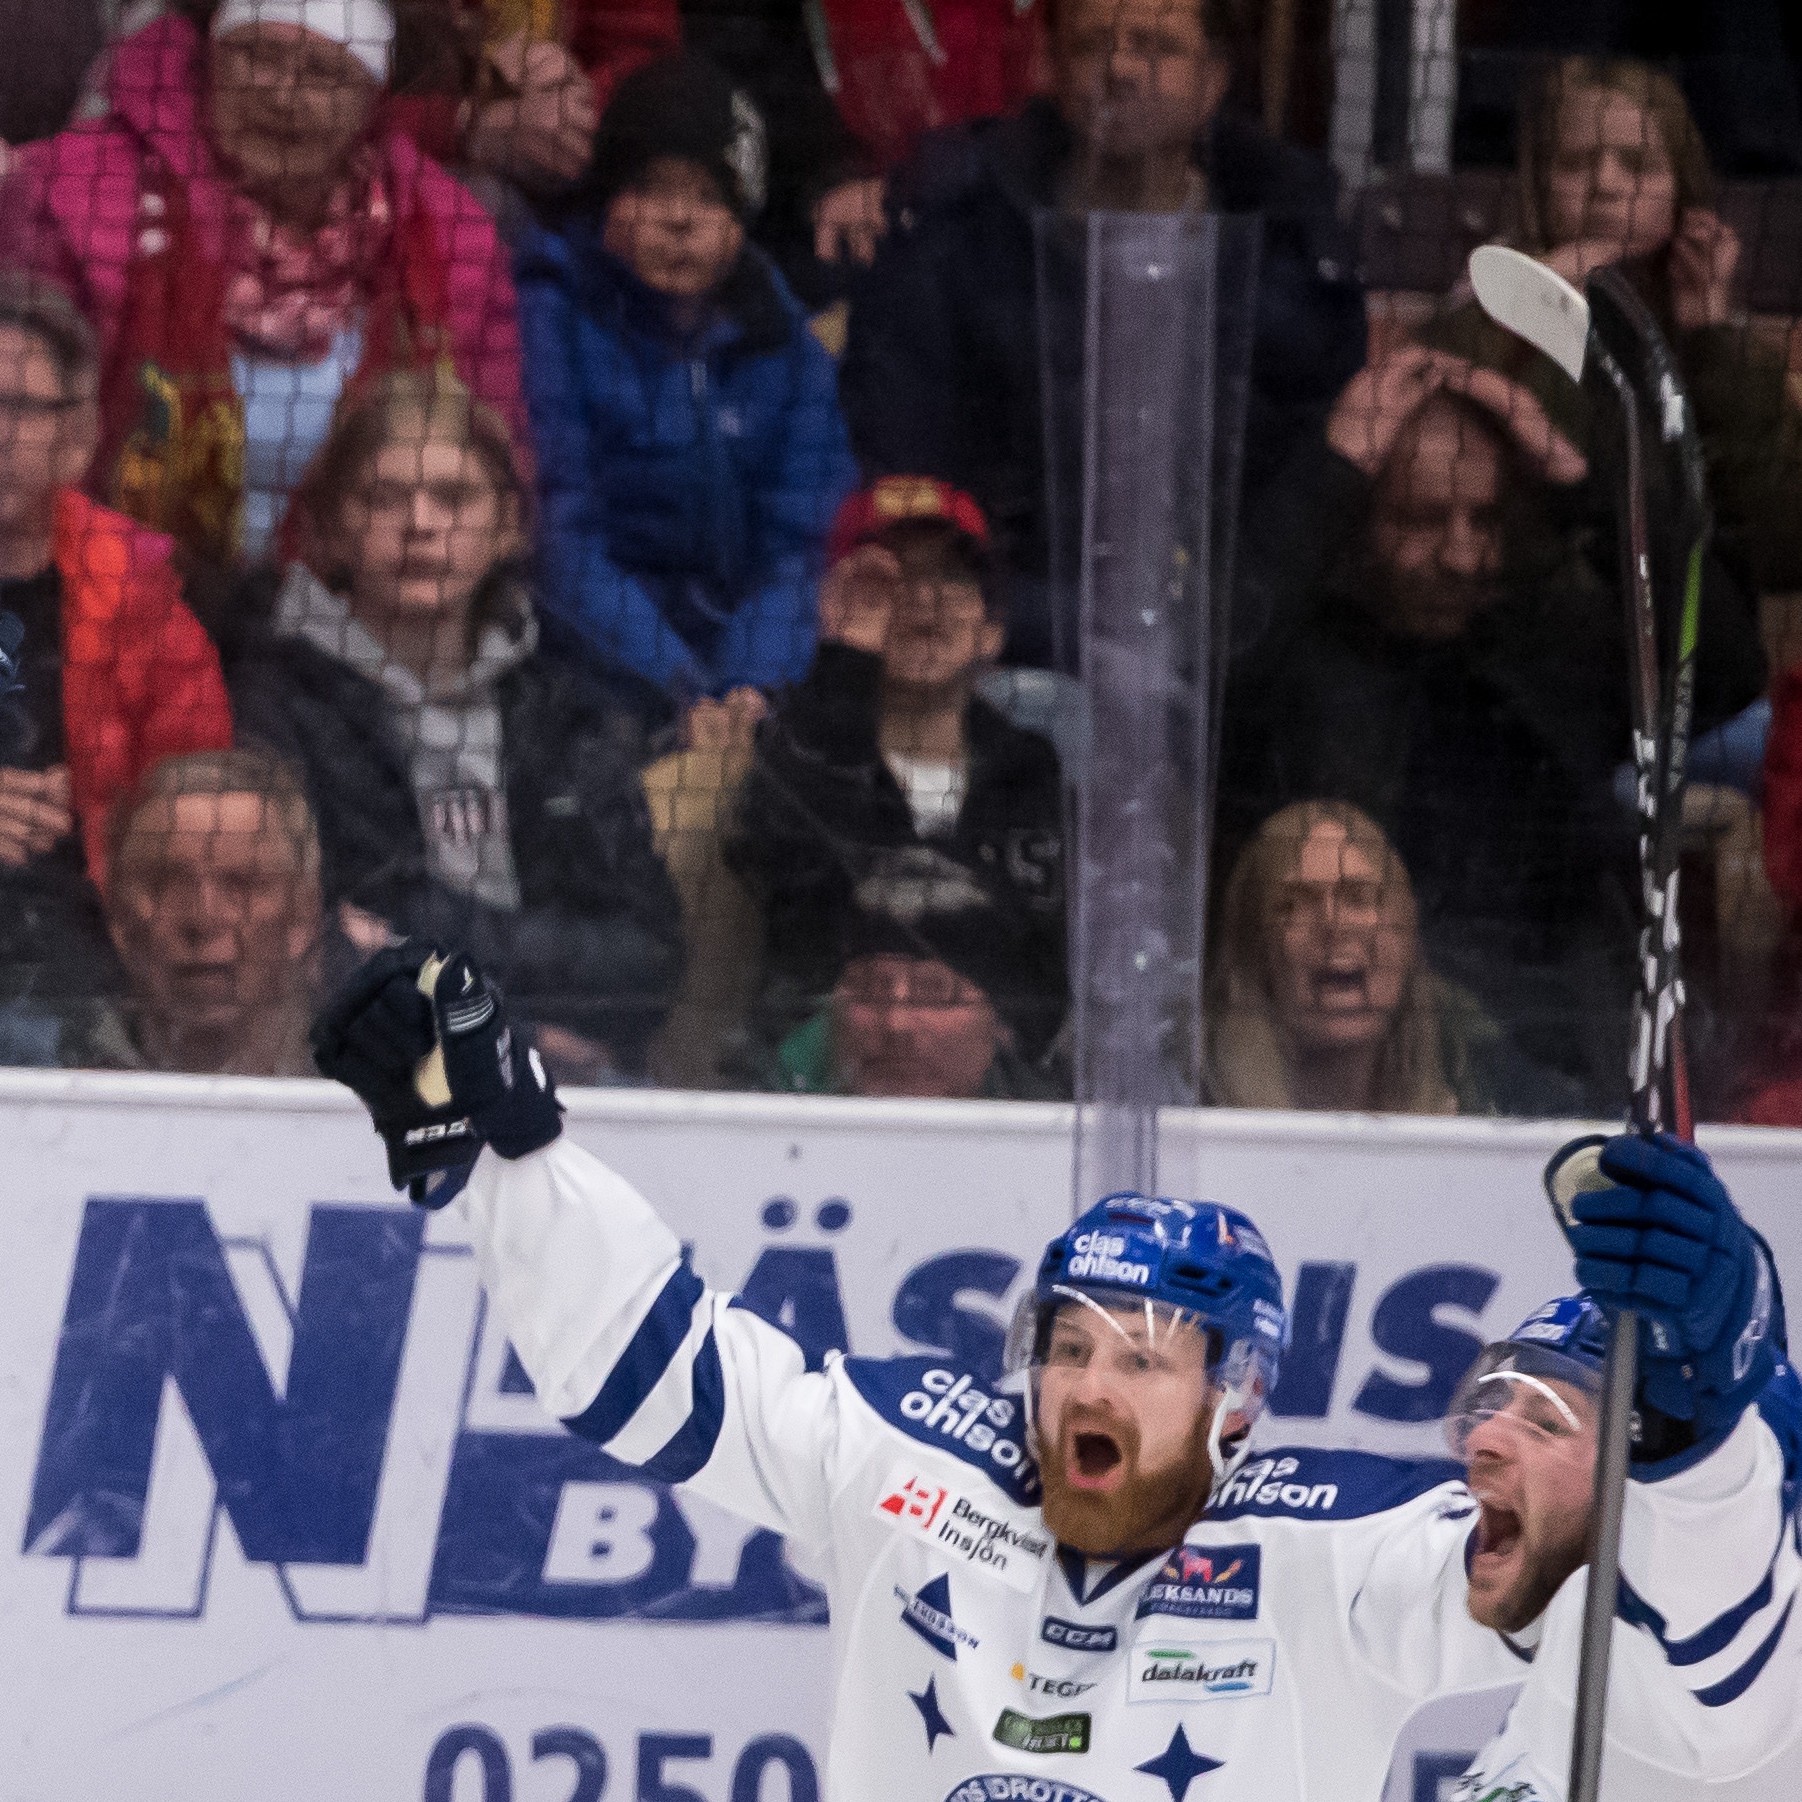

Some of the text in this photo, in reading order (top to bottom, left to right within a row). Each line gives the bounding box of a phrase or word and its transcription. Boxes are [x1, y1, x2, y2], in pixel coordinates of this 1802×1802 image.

[1073, 1230, 1126, 1257] clas
[1067, 1253, 1151, 1286] ohlson
[921, 1368, 1016, 1429] clas
[1148, 1583, 1255, 1606] EKSANDS
